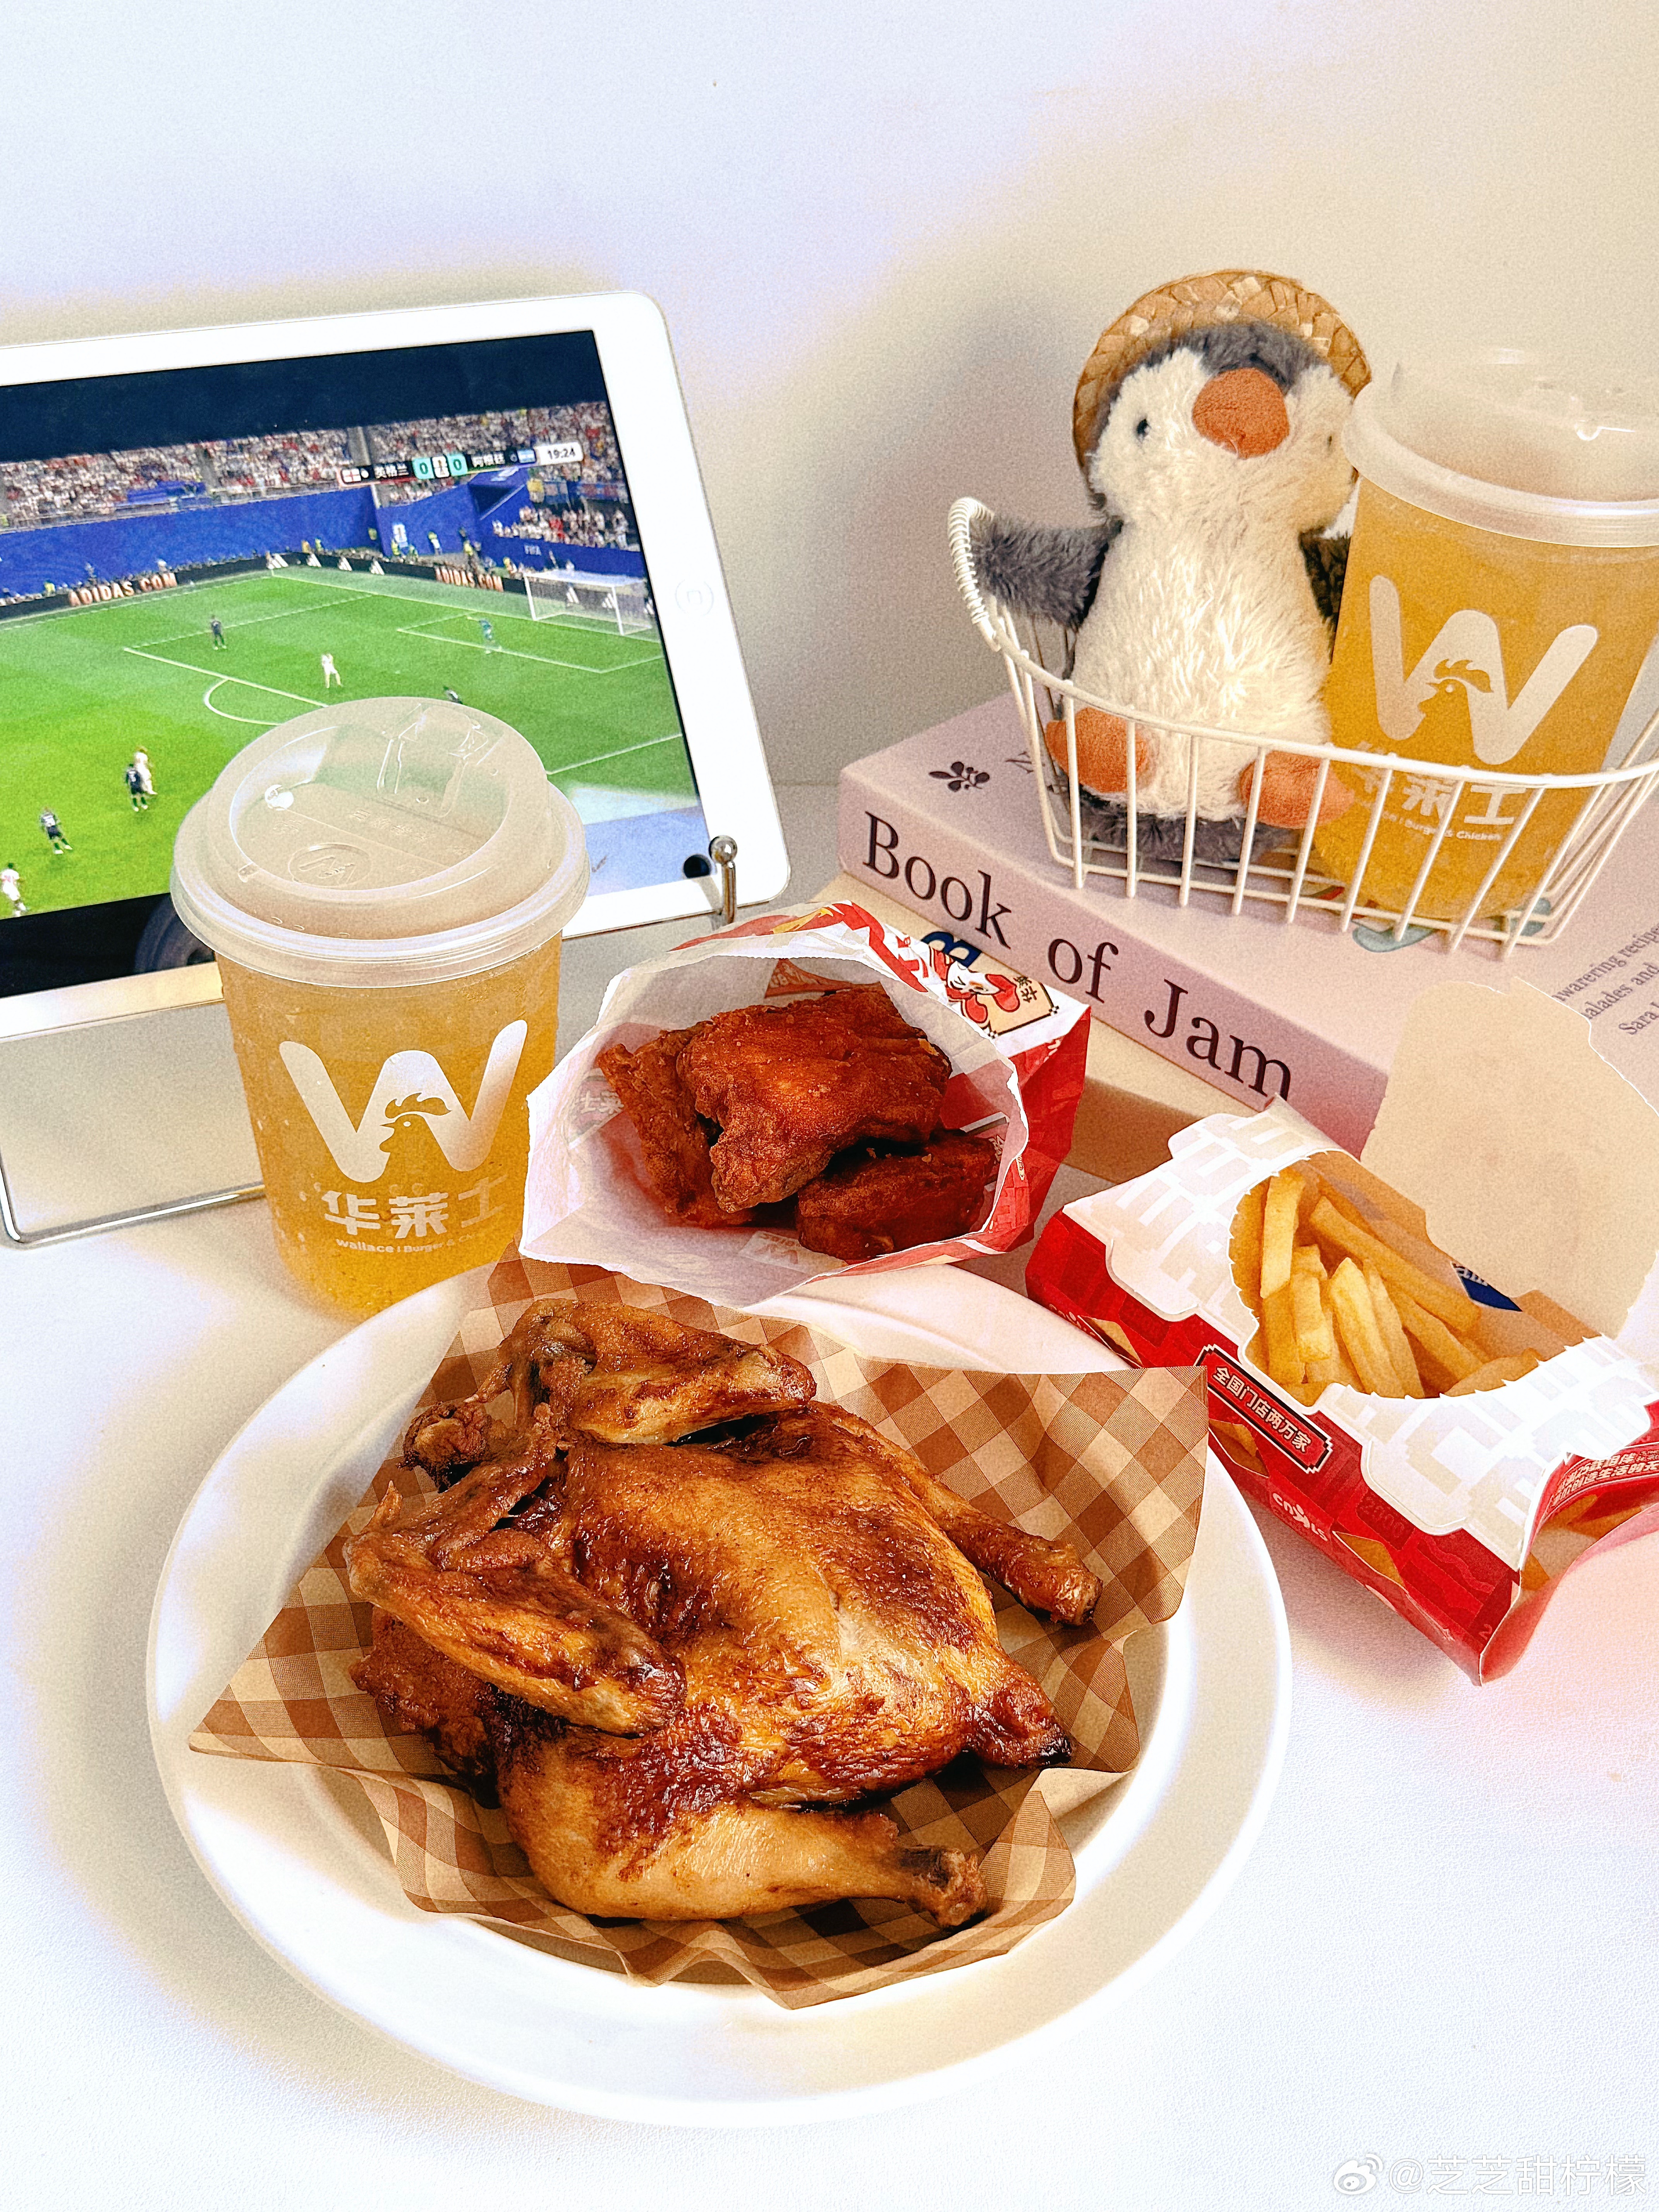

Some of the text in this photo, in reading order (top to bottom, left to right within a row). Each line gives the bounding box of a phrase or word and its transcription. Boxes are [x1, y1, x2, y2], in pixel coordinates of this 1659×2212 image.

[419, 462, 428, 474] 0
[453, 459, 462, 471] 0
[548, 448, 577, 460] 19:24
[1456, 830, 1501, 840] Chicken
[863, 811, 1291, 1101] Book of Jam
[1631, 962, 1659, 986] and
[1618, 1011, 1659, 1035] Sara
[321, 1173, 509, 1239] 华莱士
[404, 1242, 444, 1253] Burger
[1212, 1367, 1312, 1452] 全国门店两万家
